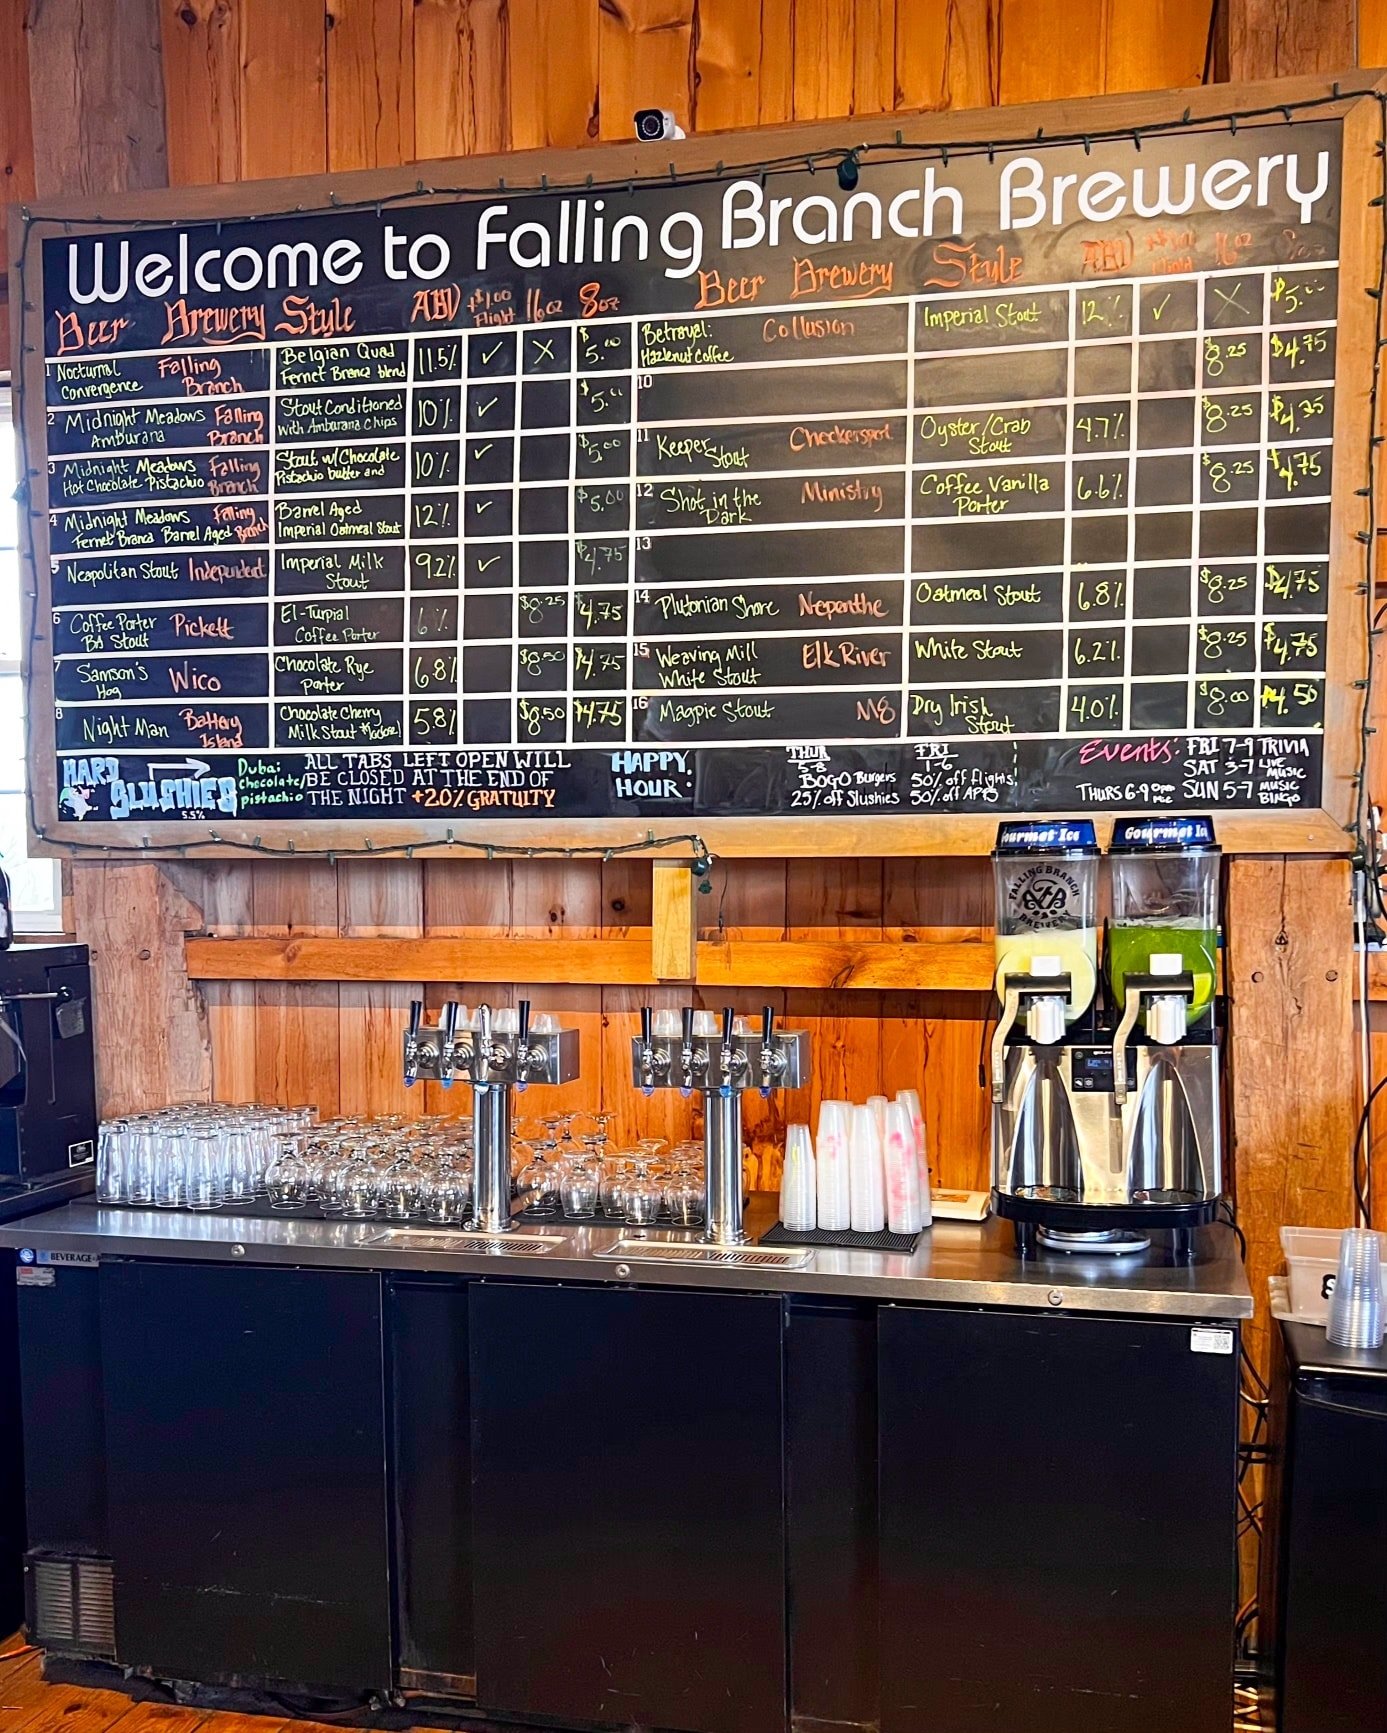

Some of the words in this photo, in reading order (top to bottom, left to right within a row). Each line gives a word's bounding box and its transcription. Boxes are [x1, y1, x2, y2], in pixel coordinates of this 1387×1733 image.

[68, 234, 364, 305] Welcome
[384, 225, 450, 279] to
[476, 201, 704, 279] Falling
[720, 168, 963, 250] Branch
[999, 152, 1330, 230] Brewery
[924, 242, 1024, 287] Style
[790, 256, 893, 300] Brewery
[694, 269, 766, 309] Beer
[161, 298, 266, 344] Brewery
[274, 295, 356, 337] Style
[924, 305, 989, 331] Imperial
[995, 303, 1041, 328] Stout
[55, 310, 128, 354] Beer
[283, 346, 349, 366] Belgian
[356, 343, 396, 359] Quad
[158, 357, 221, 378] Falling
[280, 369, 328, 386] Fernet
[61, 380, 143, 400] Convergence
[183, 379, 244, 396] Branch
[638, 375, 653, 389] 10
[281, 399, 324, 416] Stout
[325, 392, 402, 414] Conditioned
[418, 397, 454, 429] 10%
[65, 410, 141, 435] Midnight
[145, 409, 206, 424] Meadows
[215, 406, 264, 428] Falling
[91, 431, 165, 448] Amburana
[207, 430, 263, 446] Branch
[638, 428, 649, 442] 11
[656, 435, 711, 462] Keeper
[968, 437, 1012, 455] Stout
[278, 452, 318, 470] Stout
[415, 451, 450, 480] 10%
[705, 448, 750, 468] Stout
[64, 461, 130, 480] Midnight
[136, 458, 196, 474] Meadows
[209, 457, 261, 481] Falling
[364, 465, 385, 477] and
[63, 481, 84, 497] Hot
[86, 476, 143, 492] Chocolate
[208, 478, 259, 496] Branch
[637, 484, 653, 496] 12
[920, 473, 983, 495] Coffee
[989, 475, 1050, 494] Vanilla
[660, 487, 705, 512] Shot
[713, 493, 727, 509] in
[732, 487, 761, 508] the
[952, 495, 1009, 516] Porter
[276, 503, 324, 520] Barrel
[329, 501, 362, 522] Aged
[415, 502, 451, 527] 12%
[700, 508, 752, 525] Dark
[64, 512, 127, 533] Midnight
[135, 511, 191, 524] Meadows
[278, 522, 325, 538] Imperial
[72, 533, 113, 552] Fernet
[118, 530, 155, 546] Branca
[161, 527, 200, 543] Barrel
[203, 525, 232, 546] Aged
[636, 537, 652, 550] 13
[139, 563, 180, 579] Stout
[280, 554, 341, 571] Imperial
[348, 552, 384, 569] Milk
[326, 573, 370, 590] Stout
[636, 590, 649, 603] 14
[916, 582, 987, 603] Oatmeal
[994, 584, 1042, 606] Stout
[732, 594, 779, 620] Shore
[117, 612, 158, 631] Porter
[417, 607, 449, 634] 6%
[112, 633, 150, 647] Stout
[295, 627, 339, 644] Coffee
[343, 627, 380, 642] Porter
[633, 643, 650, 658] 15
[655, 645, 721, 668] Weaving
[726, 641, 758, 661] Mill
[802, 641, 840, 669] Elk
[838, 642, 891, 667] River
[914, 637, 969, 660] White
[972, 640, 1023, 660] Stout
[275, 655, 340, 673] Chocolate
[345, 655, 374, 681] Rye
[658, 669, 705, 689] White
[713, 667, 761, 686] Stout
[96, 684, 121, 699] Hog
[280, 704, 340, 721] Chocolate
[632, 696, 648, 710] 16
[660, 699, 717, 727] Magpie
[722, 697, 775, 722] Stout
[910, 694, 942, 725] Dry
[949, 693, 993, 717] Irish
[83, 716, 130, 745] Night
[134, 721, 169, 738] Man
[288, 723, 319, 740] Milk
[320, 723, 356, 740] Stout
[965, 715, 1015, 734] Stout
[786, 745, 829, 760] THUR
[915, 744, 950, 757] FRI
[1186, 736, 1220, 756] FRI
[1222, 738, 1254, 756] 7-9
[1256, 738, 1310, 756] TRIVIA
[238, 758, 281, 777] Dubai
[305, 753, 337, 770] ALL
[343, 753, 392, 769] TABS
[404, 752, 450, 768] LEFT
[457, 752, 508, 768] OPEN
[512, 751, 571, 768] WILL
[1183, 760, 1218, 777] SAT
[1258, 758, 1286, 769] LIVE
[63, 757, 120, 787] HARD
[306, 772, 330, 787] BE
[337, 770, 405, 786] CLOSED
[412, 769, 439, 786] AT
[441, 770, 483, 786] THE
[487, 769, 526, 786] END
[530, 770, 554, 786] OF
[799, 773, 852, 789] BOGO
[911, 772, 942, 789] 50%
[947, 770, 966, 785] off
[1266, 767, 1306, 779] MUSIC
[909, 789, 940, 806] 50%
[943, 787, 961, 801] off
[1076, 782, 1123, 802] THURS
[1182, 779, 1219, 800] SUN
[1222, 782, 1253, 800] 5-7
[1259, 781, 1300, 792] MUSIC
[110, 777, 237, 819] SLUSHIES
[241, 792, 304, 809] pistachio
[306, 790, 343, 806] THE
[348, 788, 407, 804] NIGHT
[467, 788, 556, 810] GRATUITY
[791, 791, 822, 809] 25%
[823, 790, 844, 807] off
[846, 790, 900, 807] Slushies
[1257, 792, 1300, 806] BINGO
[1195, 824, 1207, 837] Ic
[1008, 866, 1043, 900] FALLING
[1045, 865, 1080, 896] BRANCH
[1018, 910, 1071, 929] BREWERY
